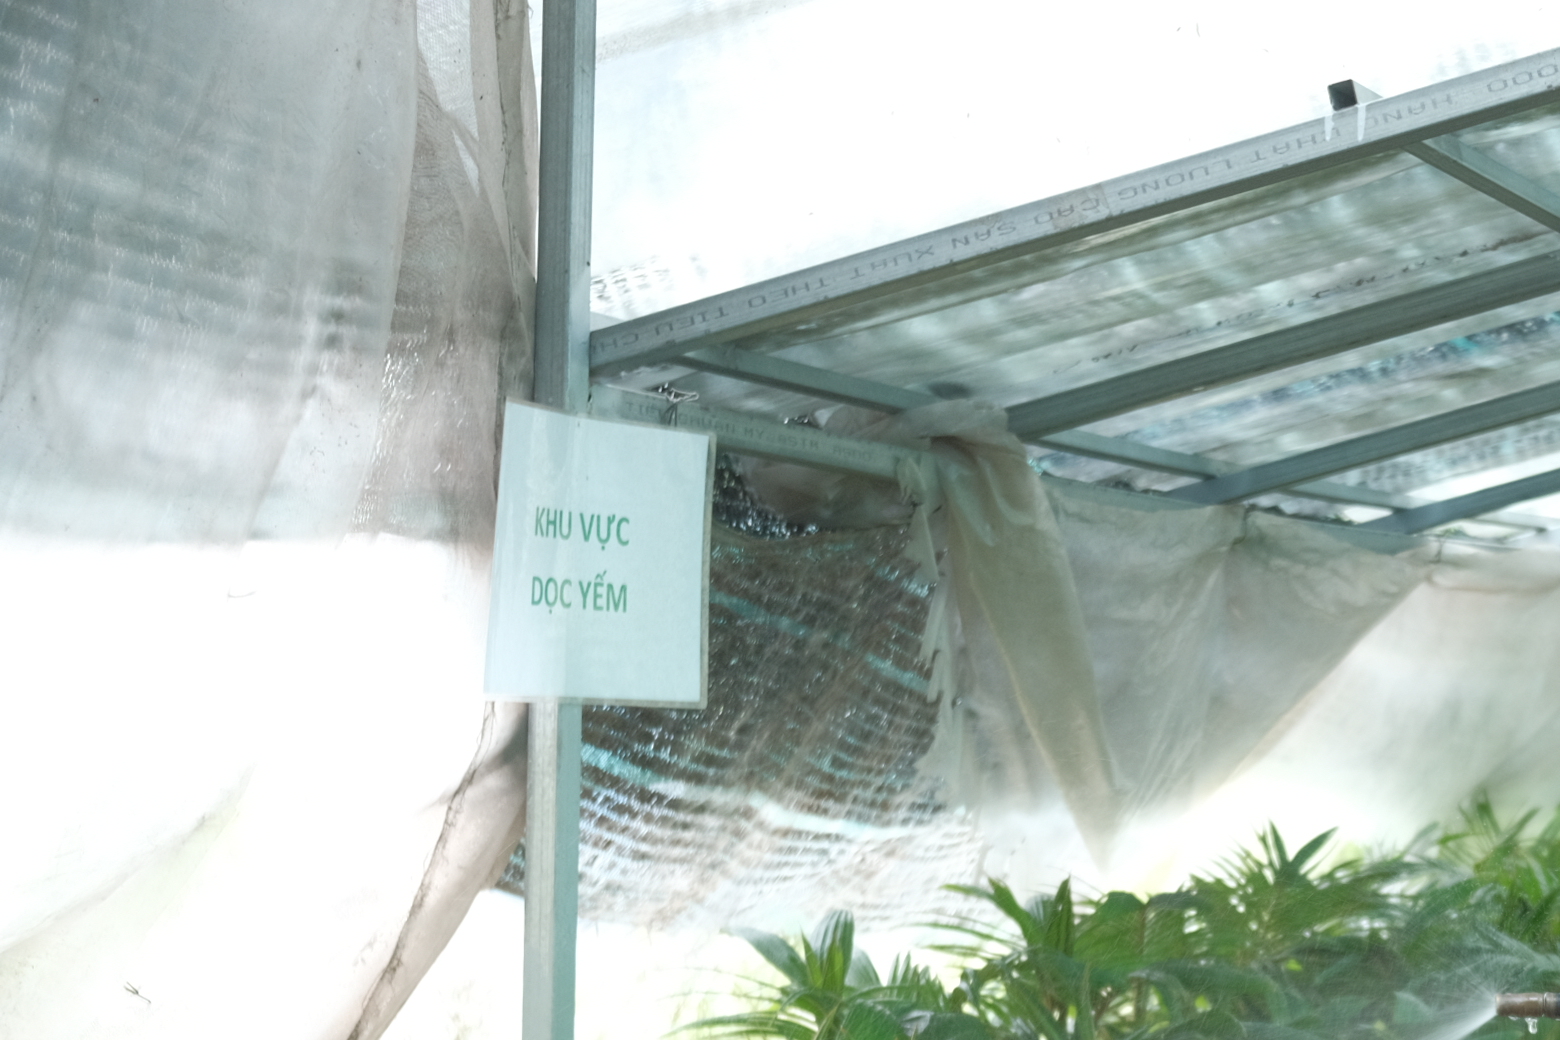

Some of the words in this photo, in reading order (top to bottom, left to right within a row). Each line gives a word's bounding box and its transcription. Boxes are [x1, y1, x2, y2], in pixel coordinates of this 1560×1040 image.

[1115, 157, 1232, 202] LUONG
[1031, 195, 1101, 226] CAO
[949, 219, 1017, 251] SAN
[744, 271, 836, 310] THEO
[652, 302, 730, 337] TIEU
[590, 329, 641, 355] CH
[535, 506, 572, 541] KHU
[579, 512, 630, 551] VỰC
[531, 576, 573, 614] DỌC
[579, 569, 628, 613] YẾM
